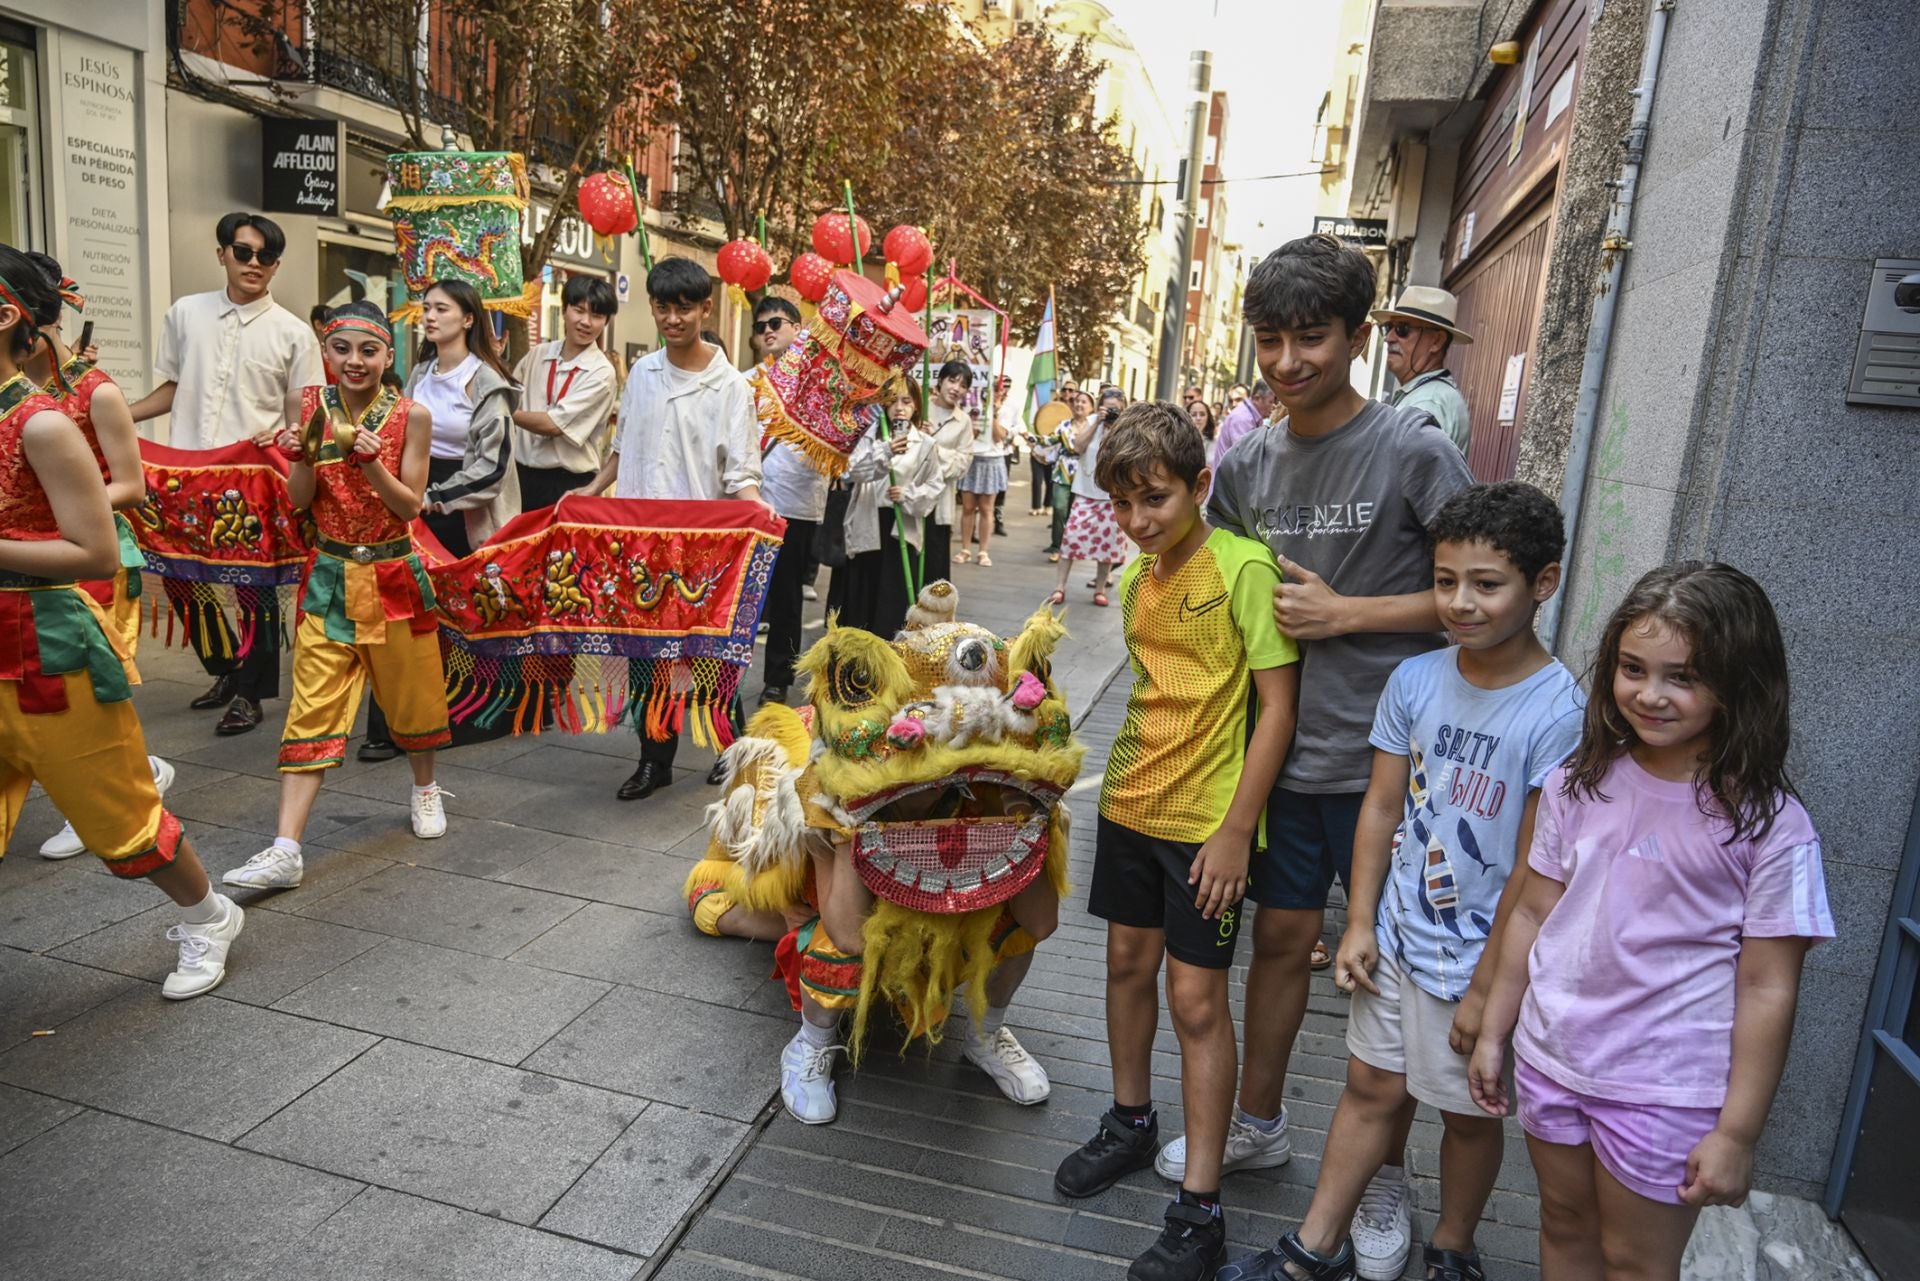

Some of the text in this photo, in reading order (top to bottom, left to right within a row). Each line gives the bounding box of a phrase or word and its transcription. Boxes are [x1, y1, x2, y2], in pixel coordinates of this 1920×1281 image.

[80, 56, 120, 80] JESÚS
[64, 72, 135, 103] ESPINOSA
[67, 136, 137, 161] ESPECIALISTA
[295, 134, 335, 152] ALAIN
[71, 154, 134, 176] EN PÉRDIDA
[272, 152, 335, 172] AFFLELOU
[81, 172, 126, 190] DE PESO
[92, 207, 117, 219] DIETA
[69, 216, 142, 236] PERSONALIZADA
[1335, 224, 1387, 239] SILBON
[82, 250, 132, 265] NUTRICIÓN
[89, 264, 125, 276] CLÍNICA
[84, 294, 133, 307] NUTRICIÓN
[85, 307, 133, 320] DEPORTIVA
[1434, 724, 1501, 770] SALTY
[1448, 767, 1506, 820] WILD
[1219, 906, 1235, 938] CR
